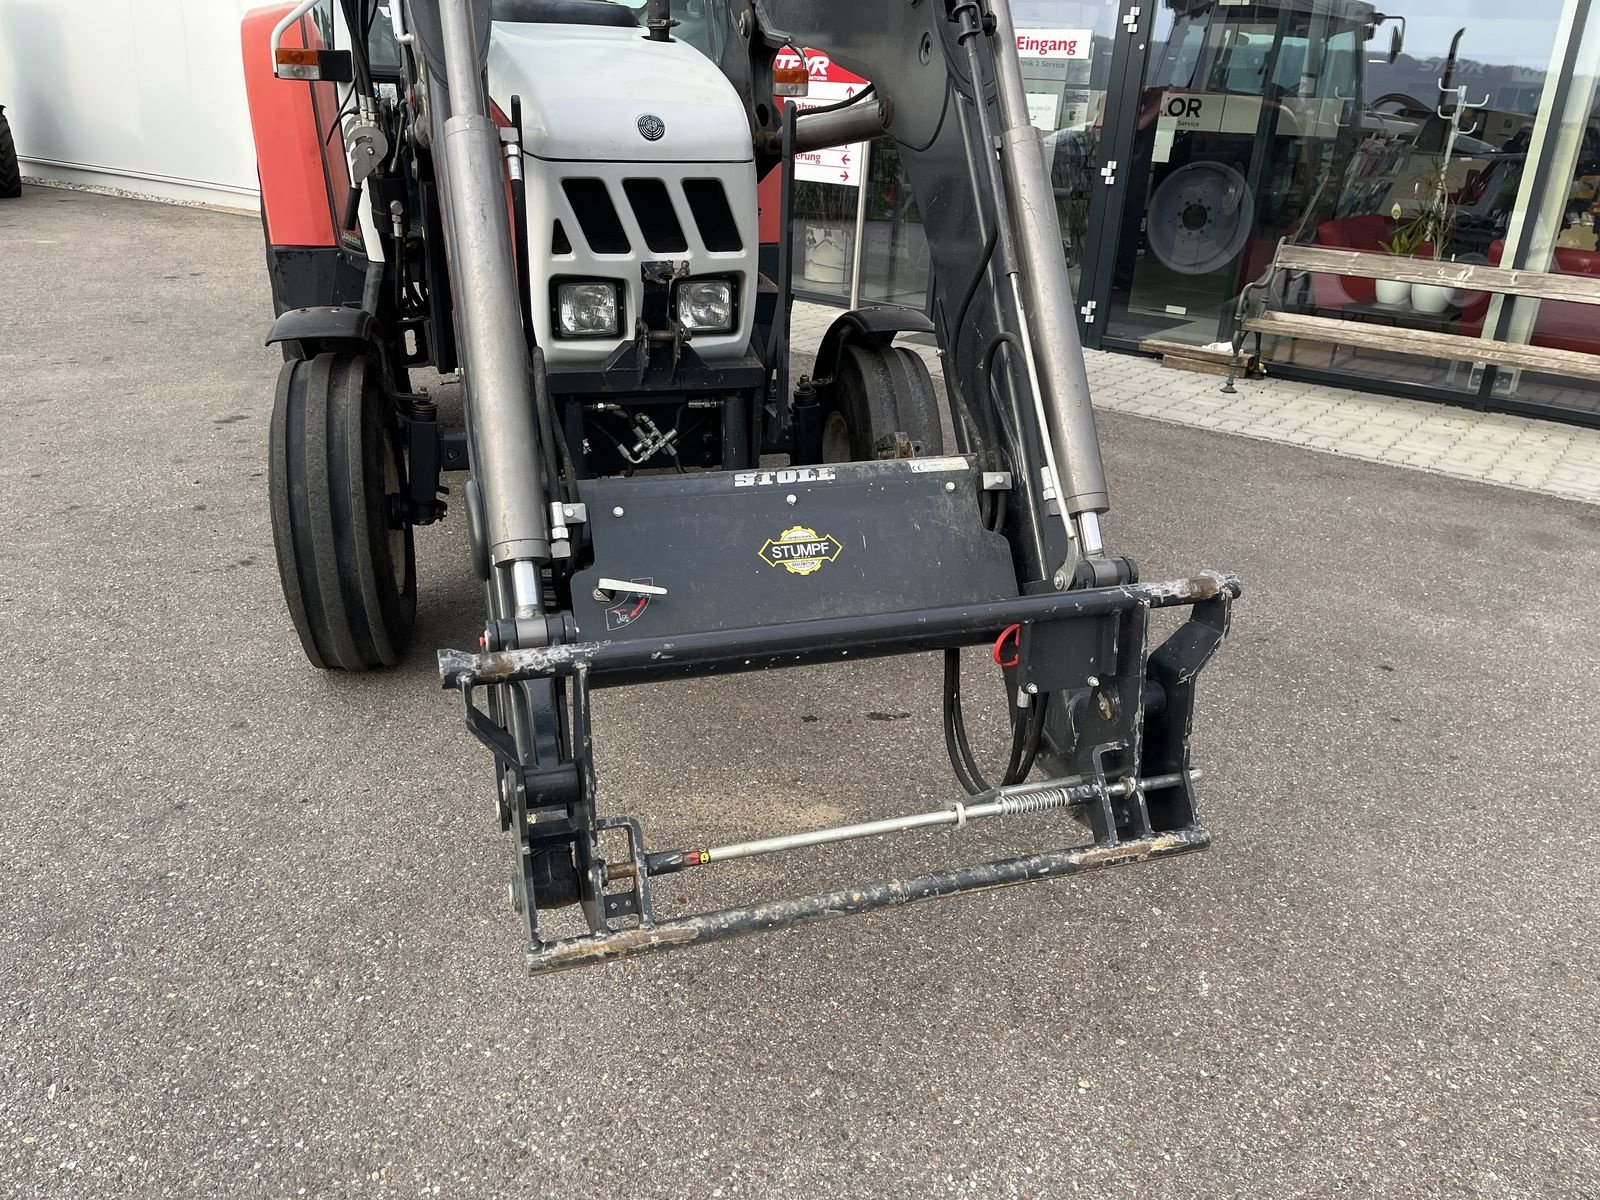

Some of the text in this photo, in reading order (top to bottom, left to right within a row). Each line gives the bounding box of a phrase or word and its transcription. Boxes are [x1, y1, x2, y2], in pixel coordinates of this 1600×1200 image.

[1017, 36, 1077, 55] Eingang
[1168, 97, 1203, 118] OR
[796, 152, 821, 165] erung
[771, 542, 829, 559] STUMPF
